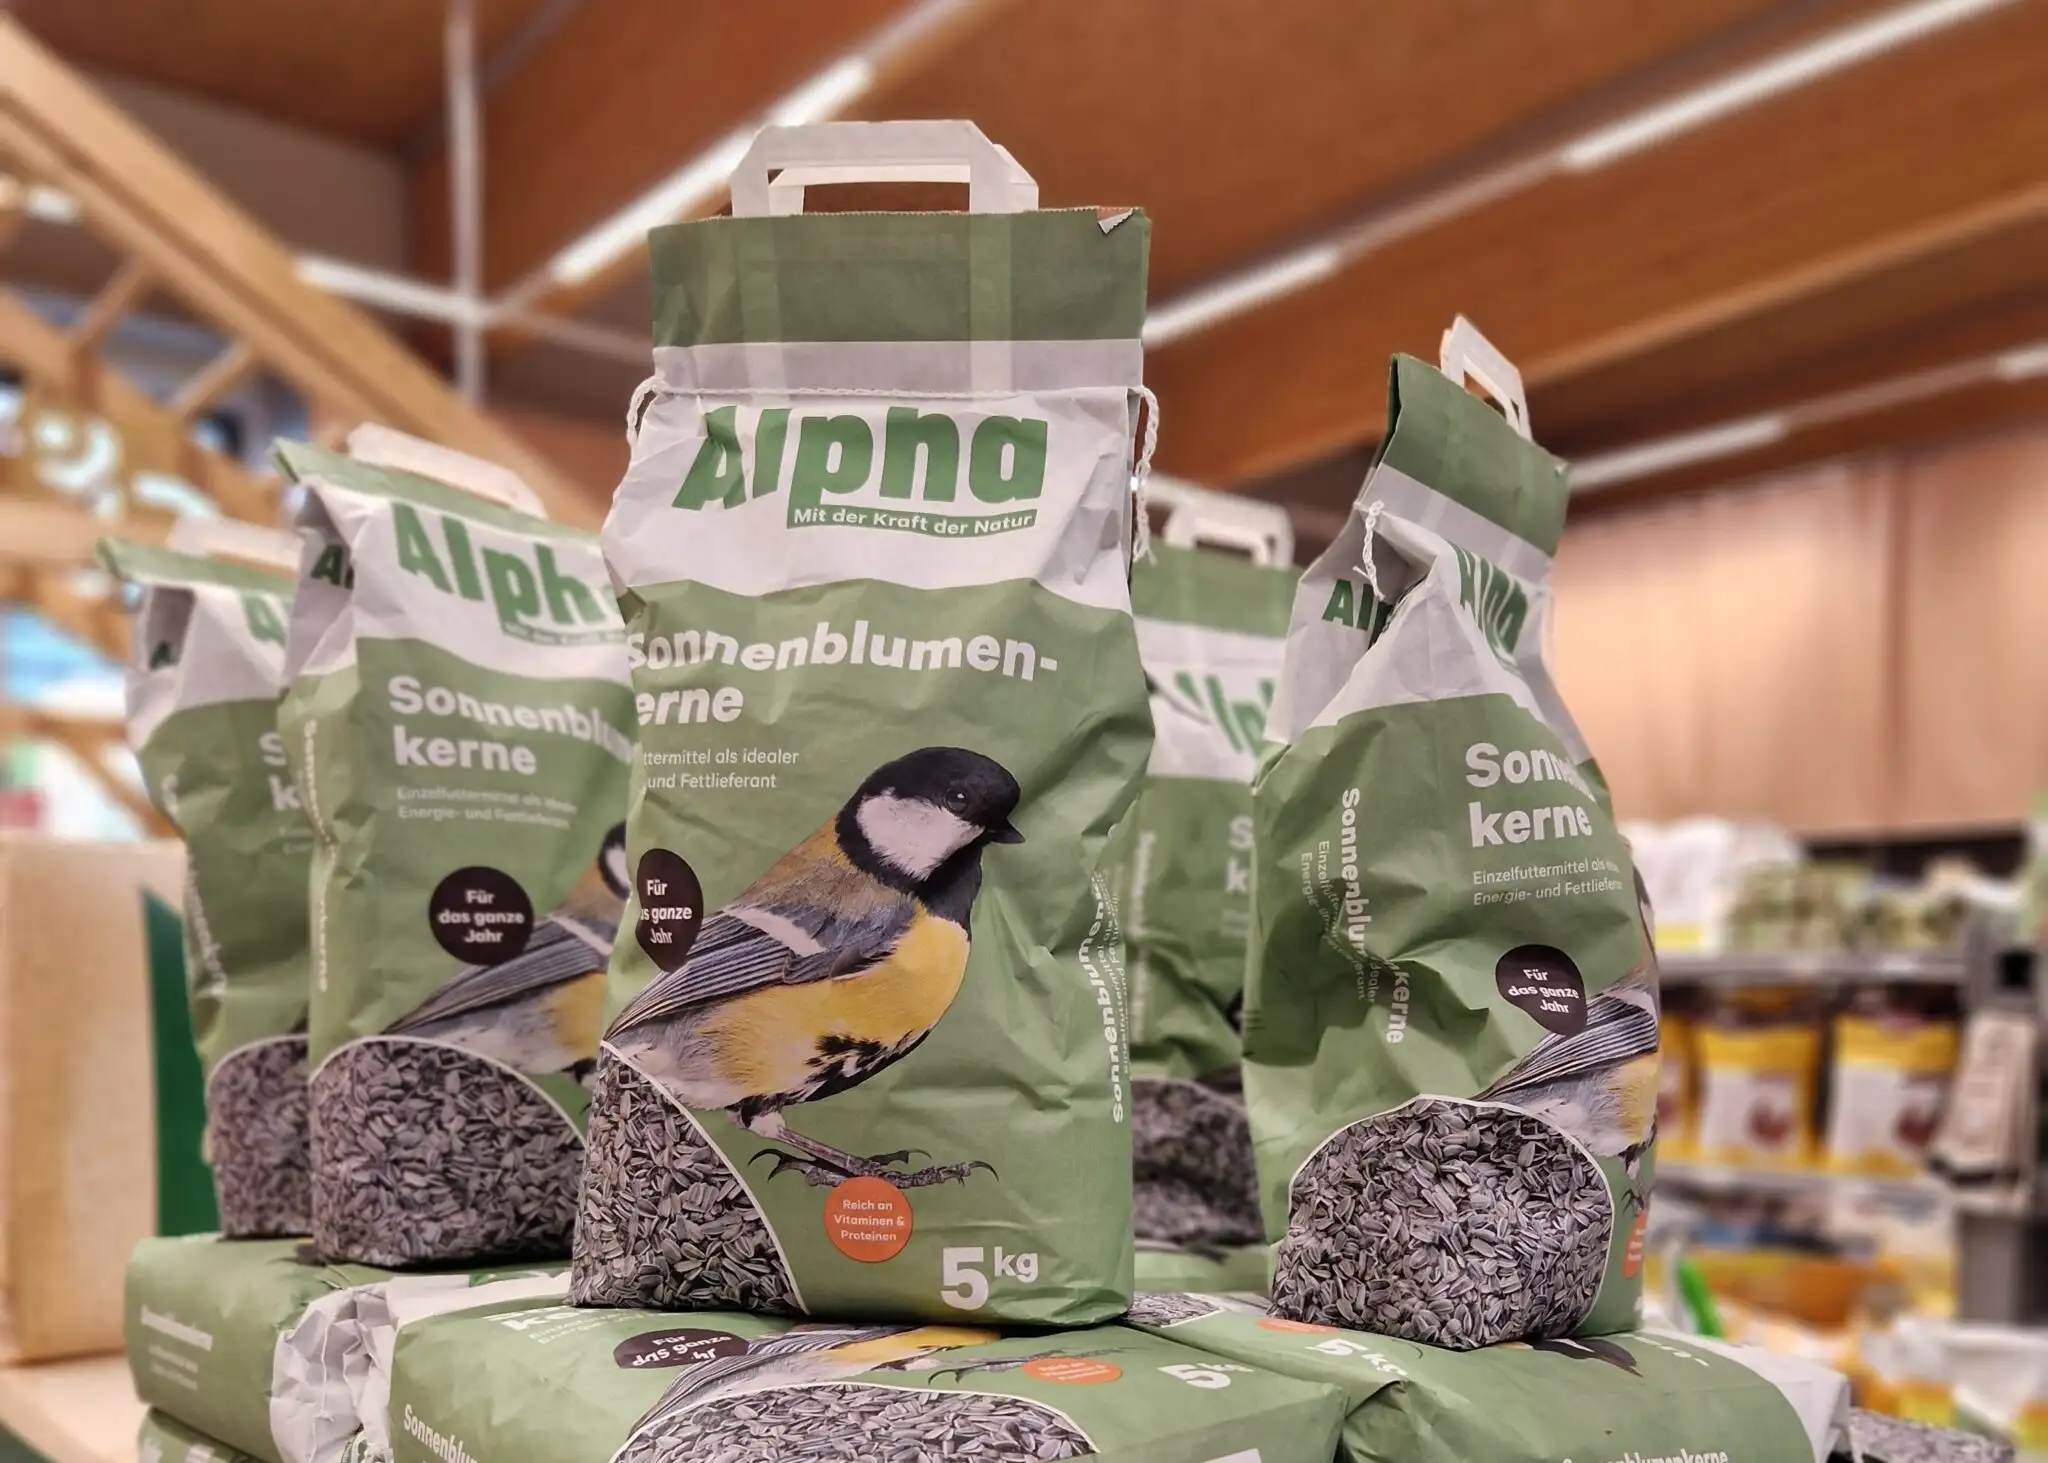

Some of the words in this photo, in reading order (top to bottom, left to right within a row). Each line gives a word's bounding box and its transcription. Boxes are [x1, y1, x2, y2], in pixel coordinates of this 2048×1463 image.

[794, 508, 826, 523] Mit
[832, 508, 868, 525] der
[873, 512, 928, 532] Kraft
[934, 520, 968, 536] der
[974, 512, 1034, 534] Natur
[391, 503, 622, 630] Alph
[636, 686, 744, 726] erne
[395, 725, 538, 775] kerne
[714, 749, 738, 764] als
[743, 748, 800, 764] idealer
[647, 774, 676, 789] und
[680, 773, 777, 789] Fettlieferant
[1468, 801, 1593, 848] kerne
[1473, 861, 1588, 885] Einzelfuttermittel
[1590, 857, 1605, 870] als
[646, 879, 668, 896] Für
[1473, 888, 1532, 906] Energie-
[1536, 882, 1561, 899] und
[465, 889, 495, 904] Für
[437, 909, 471, 924] das
[473, 911, 525, 926] ganze
[651, 907, 693, 924] ganze
[463, 930, 504, 943] Jahr
[650, 927, 673, 944] Jahr
[1523, 968, 1549, 981] Für
[1508, 985, 1538, 997] das
[1539, 986, 1579, 999] ganze
[1540, 999, 1570, 1014] Jahr
[842, 1199, 874, 1211] Reich
[877, 1201, 893, 1211] an
[834, 1213, 893, 1227] Vitaminen
[896, 1215, 905, 1227] &
[840, 1229, 897, 1242] Proteinen
[940, 1246, 989, 1311] 5
[994, 1246, 1039, 1283] kg
[652, 1334, 686, 1346] Für
[632, 1346, 670, 1368] das
[671, 1335, 733, 1356] ganze
[1157, 1363, 1232, 1390] 5
